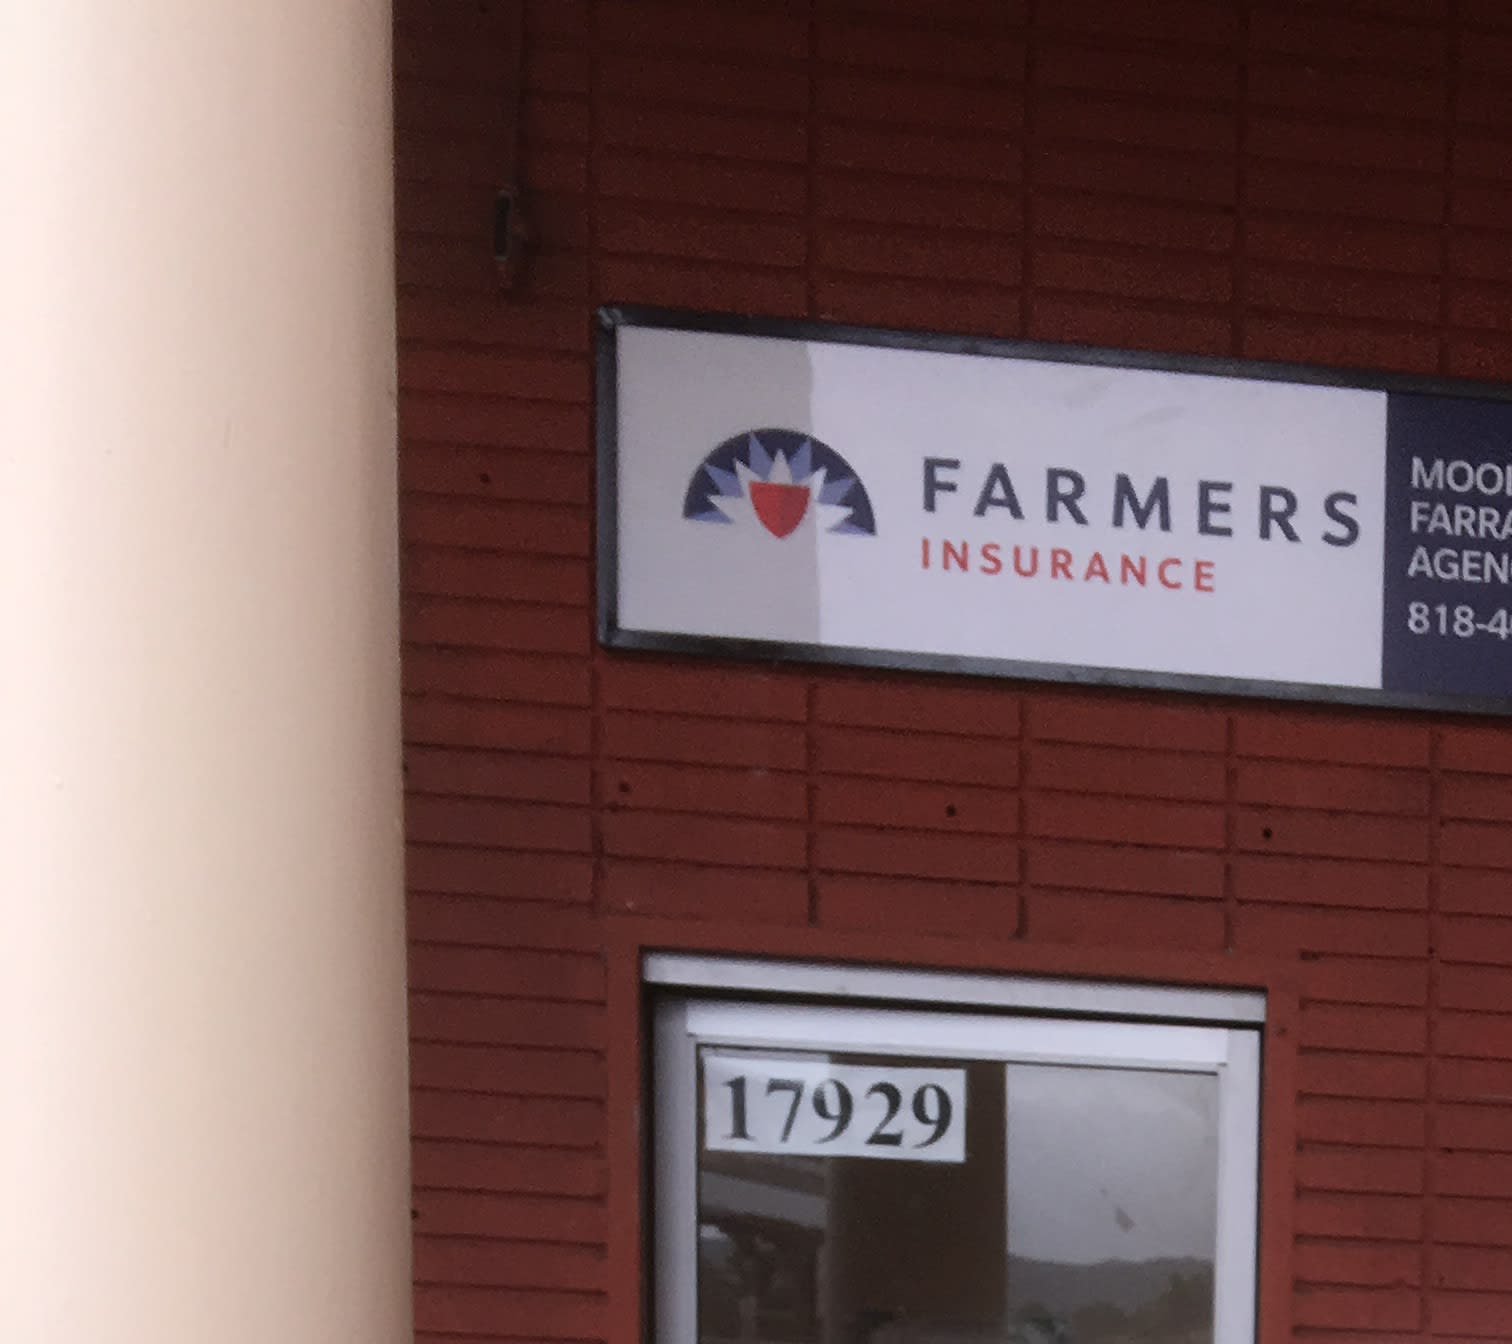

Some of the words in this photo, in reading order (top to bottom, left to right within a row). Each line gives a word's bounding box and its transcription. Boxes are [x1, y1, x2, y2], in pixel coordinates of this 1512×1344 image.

[921, 457, 1361, 549] FARMERS
[920, 538, 1217, 593] INSURANCE
[721, 1075, 952, 1150] 17929
